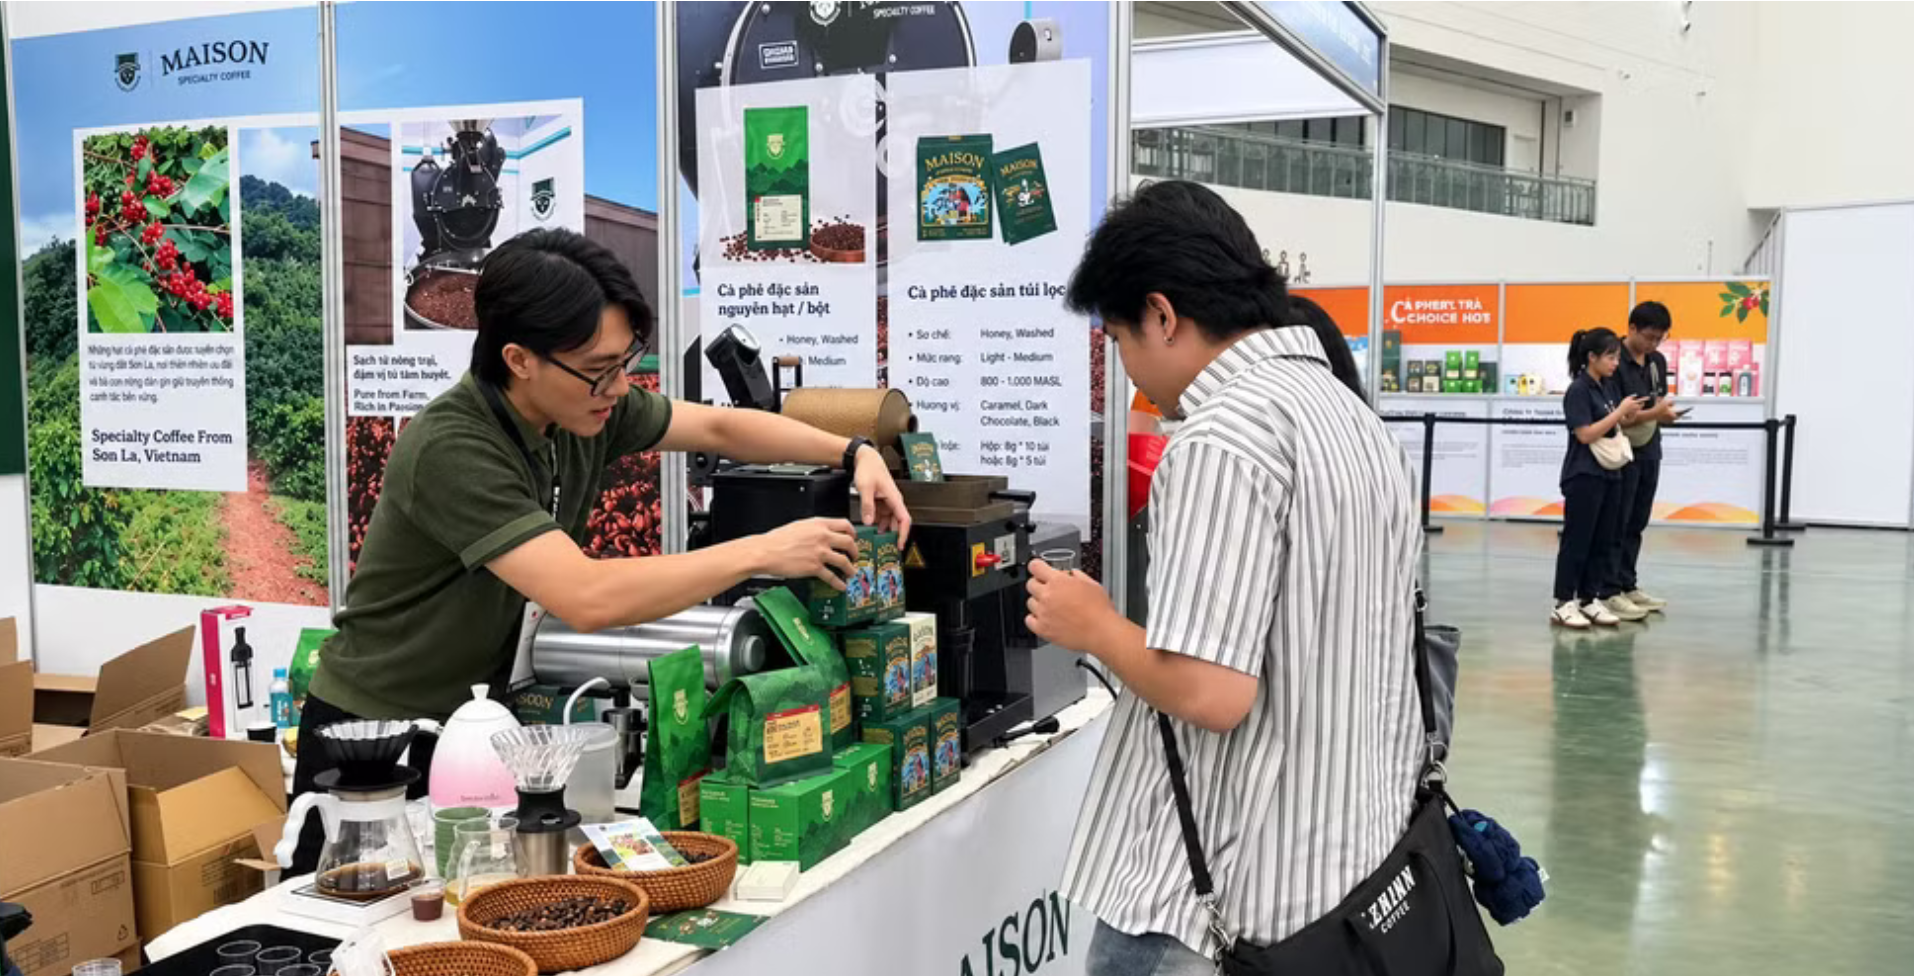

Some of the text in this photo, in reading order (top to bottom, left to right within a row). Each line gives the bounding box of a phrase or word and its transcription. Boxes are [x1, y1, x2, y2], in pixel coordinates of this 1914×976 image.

[873, 5, 936, 19] SPECIALTY COFFEE
[160, 40, 270, 76] MAISON
[177, 70, 251, 86] SPECIALTY COFFEE
[924, 151, 985, 172] MAISON
[718, 281, 819, 300] Cà phê đặc sản
[908, 282, 1066, 302] Cà phê đặc sản túi lọc
[718, 302, 769, 318] nguyên
[772, 301, 795, 317] hạt
[807, 301, 831, 317] bột
[1406, 312, 1459, 323] CHOICE
[786, 334, 859, 346] Honey, Washed
[980, 328, 1054, 341] Honey, Washed
[808, 356, 847, 366] Medium
[980, 352, 1005, 365] Light
[1013, 352, 1053, 362] Medium
[980, 376, 999, 387] 800
[1033, 376, 1062, 387] MASL
[353, 389, 376, 399] Pure
[377, 389, 400, 399] from
[353, 401, 376, 411] Rich
[377, 401, 386, 411] in
[980, 400, 1048, 412] Caramel, Dark
[980, 416, 1060, 428] Chocolate, Black
[91, 429, 232, 446] Specialty Coffee From
[1004, 441, 1017, 452] 8g
[1025, 441, 1036, 451] 10
[120, 448, 141, 464] La,
[143, 448, 201, 463] Vietnam
[1005, 456, 1018, 468] 8g
[1025, 456, 1032, 465] 5
